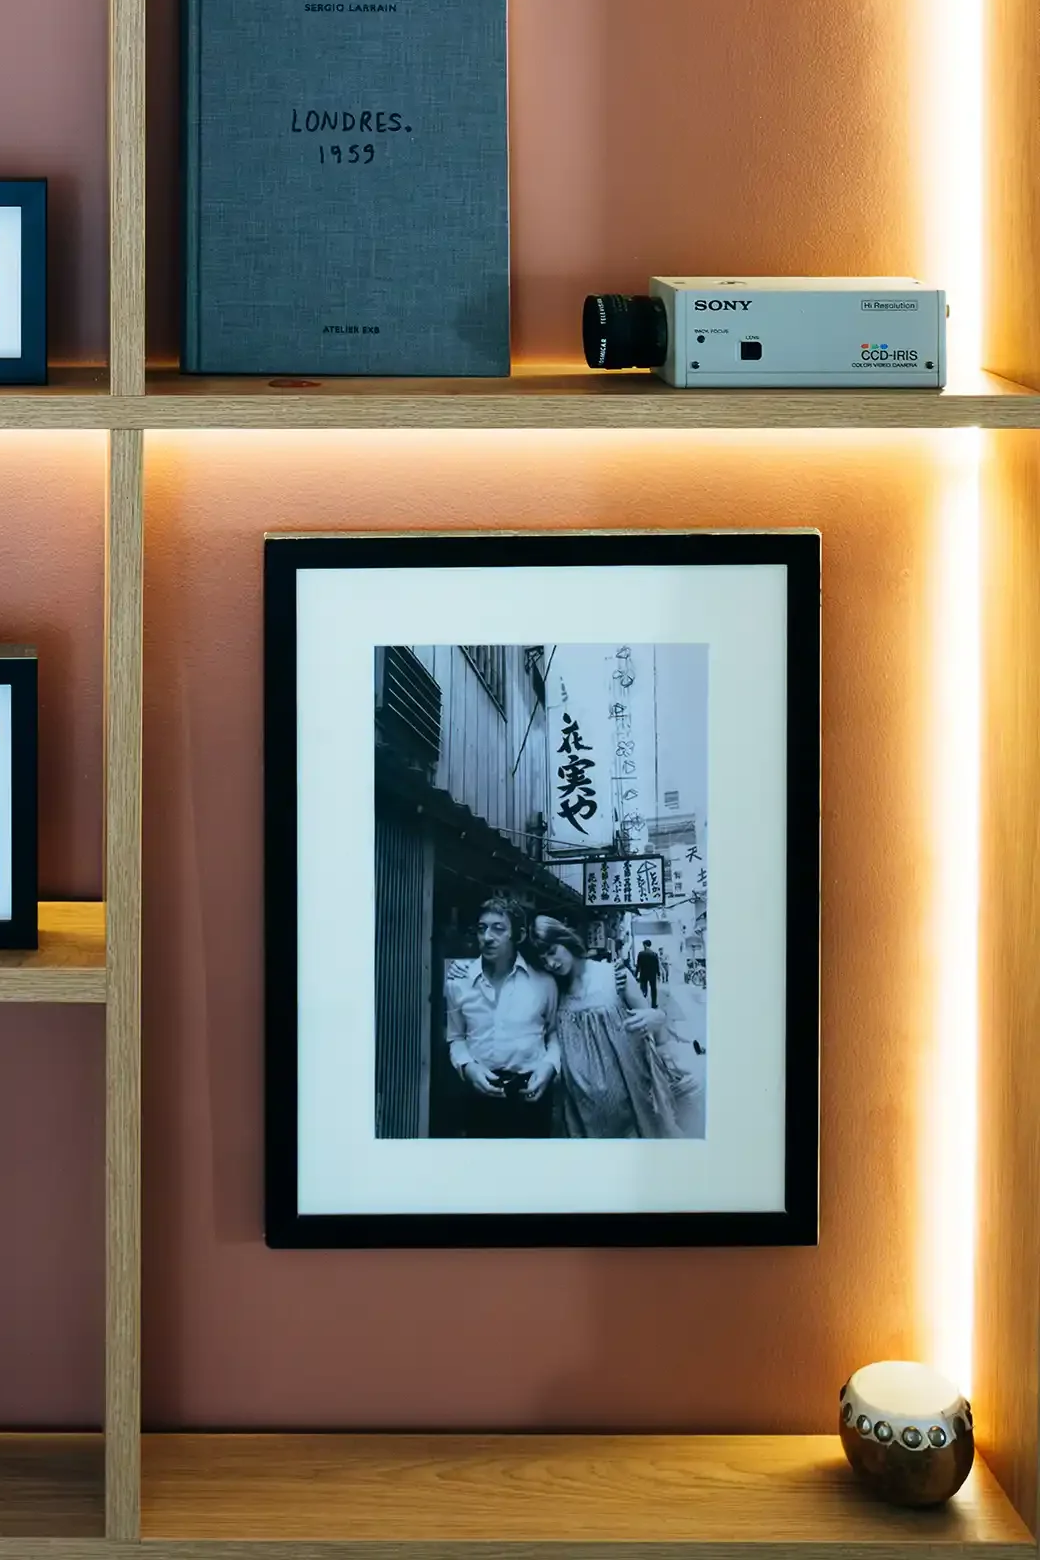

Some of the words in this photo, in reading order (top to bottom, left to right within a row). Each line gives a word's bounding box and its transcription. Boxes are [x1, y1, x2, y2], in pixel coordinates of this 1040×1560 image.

[304, 3, 345, 12] SERGIO
[348, 3, 397, 12] LARRAIN
[291, 108, 413, 133] LONDRES.
[318, 143, 376, 164] 1959
[694, 300, 753, 311] SONY
[874, 301, 916, 309] Resolution
[322, 325, 359, 334] ATELIER
[861, 349, 918, 361] CCD-IRIS
[557, 712, 598, 836] 花実や
